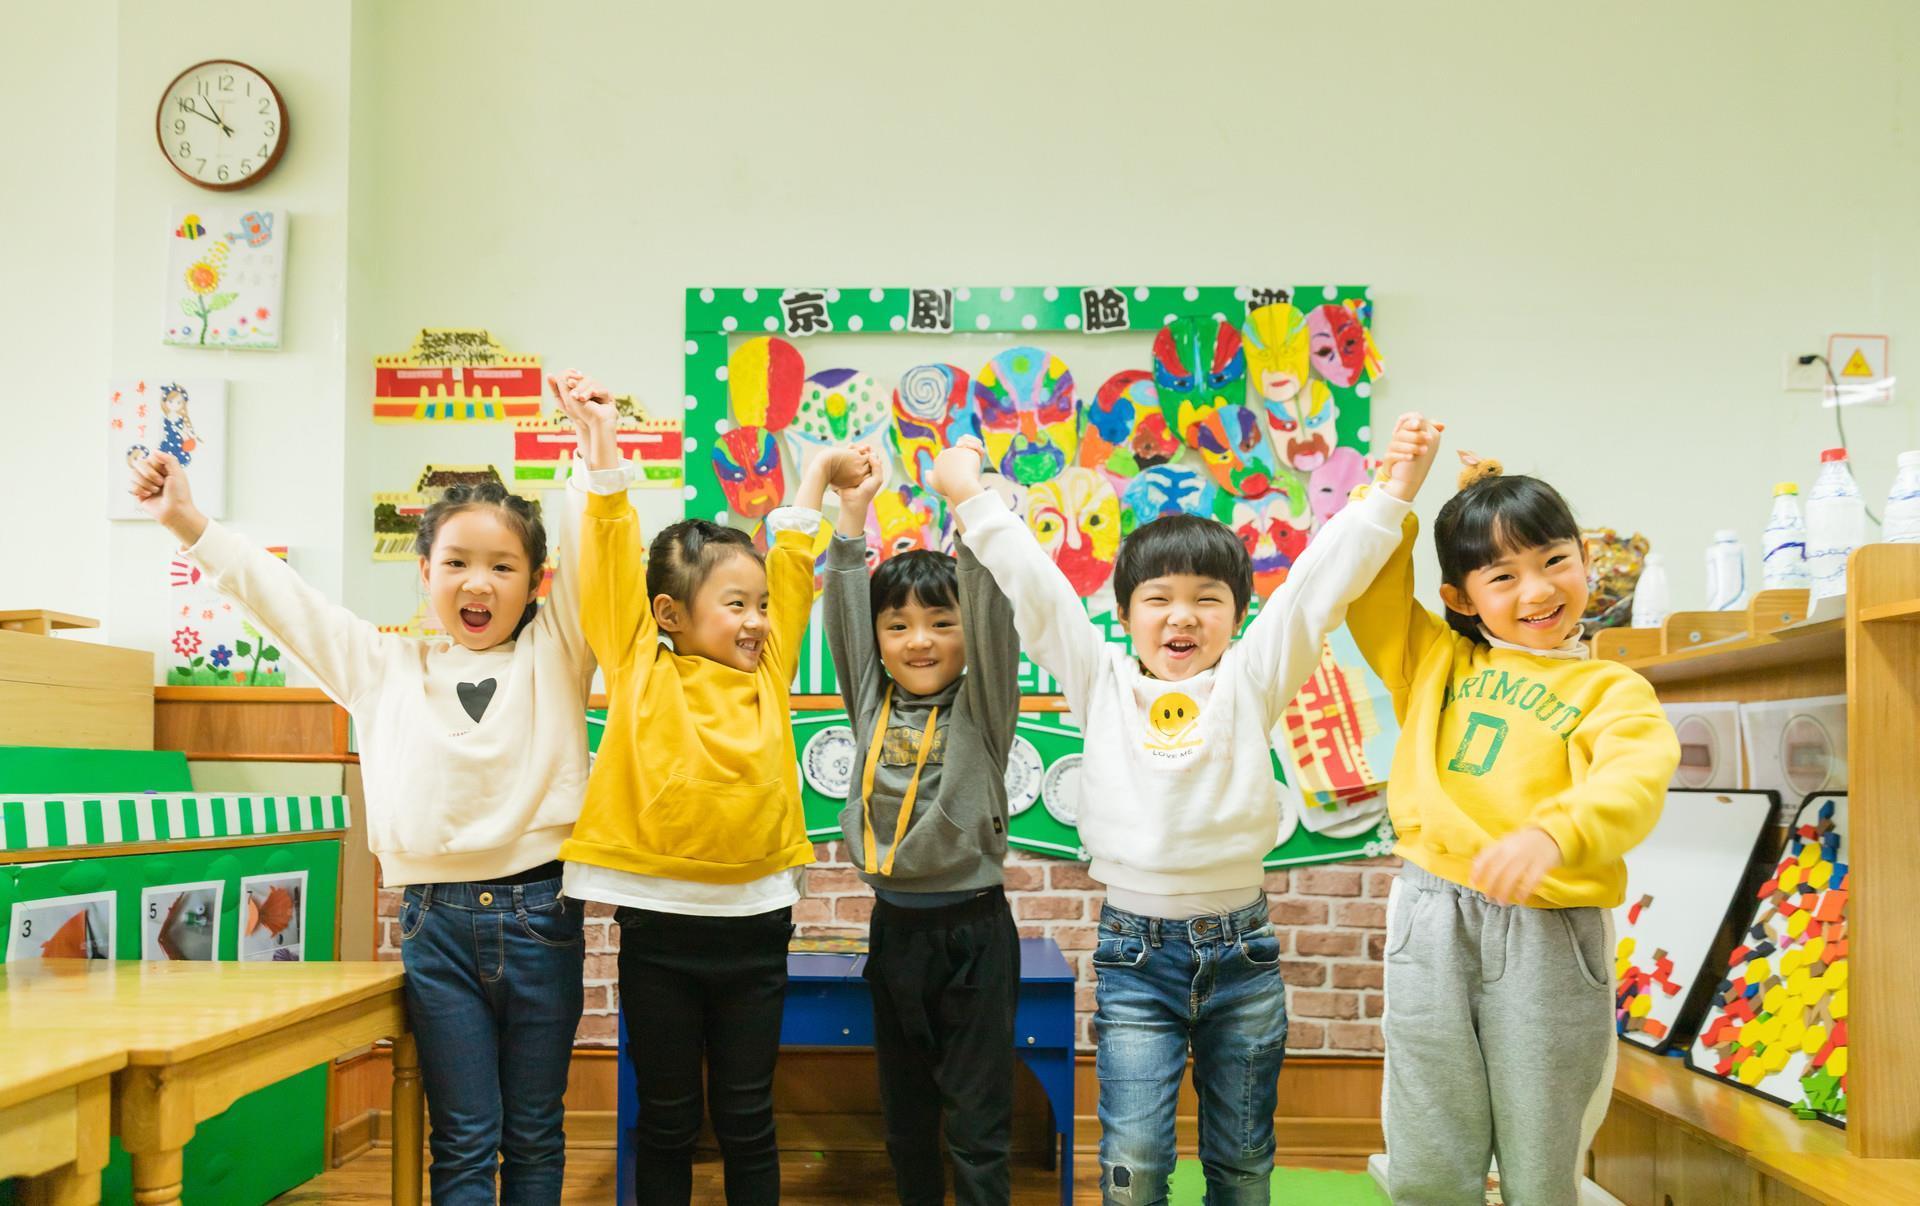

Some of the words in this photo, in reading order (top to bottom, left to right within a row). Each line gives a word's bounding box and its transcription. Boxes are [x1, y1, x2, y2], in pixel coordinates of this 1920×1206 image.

[197, 80, 209, 97] 11
[218, 75, 235, 92] 12
[246, 81, 251, 98] 1
[178, 96, 196, 113] 10
[258, 97, 271, 115] 2
[174, 118, 186, 136] 9
[263, 120, 276, 138] 3
[179, 141, 192, 159] 8
[256, 143, 269, 159] 4
[195, 158, 207, 175] 7
[217, 164, 229, 182] 6
[239, 158, 252, 177] 5
[1448, 711, 1509, 777] D
[1152, 750, 1177, 759] LOVE
[1180, 748, 1193, 757] ME
[149, 902, 158, 920] 5
[21, 919, 32, 938] 3
